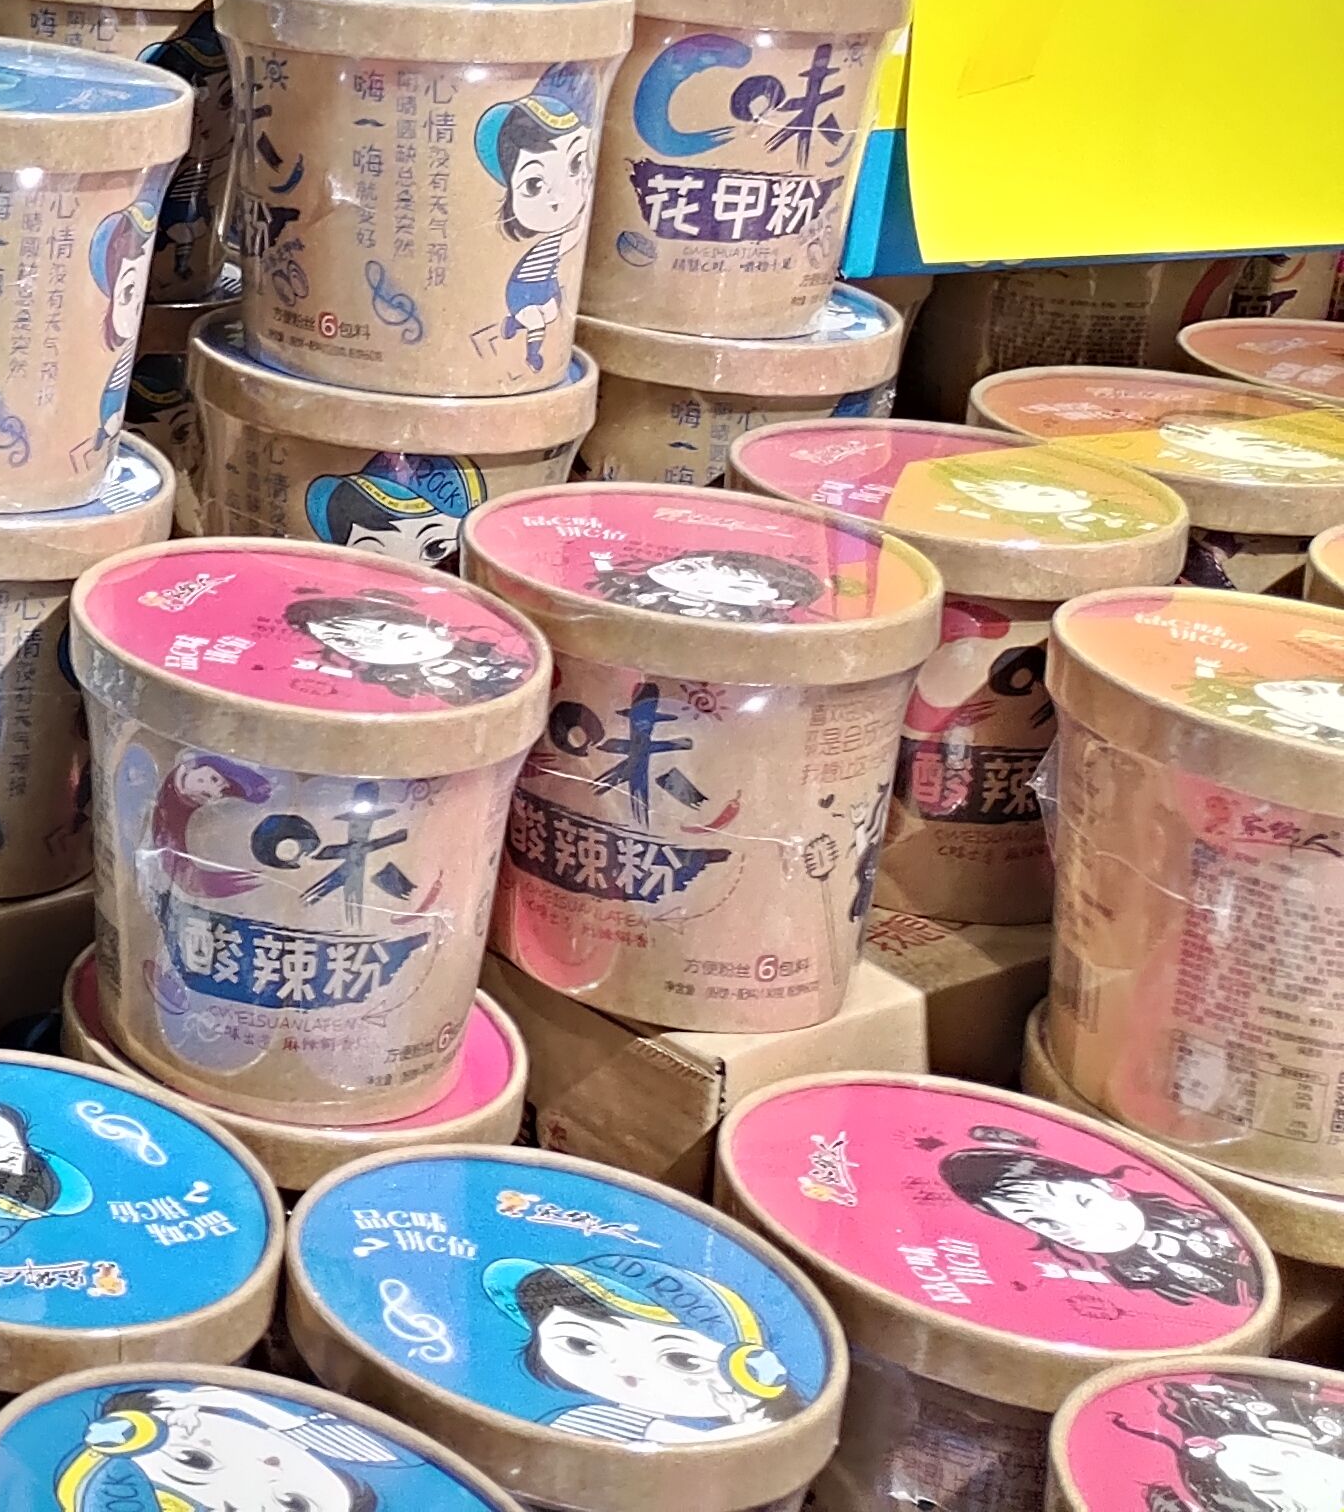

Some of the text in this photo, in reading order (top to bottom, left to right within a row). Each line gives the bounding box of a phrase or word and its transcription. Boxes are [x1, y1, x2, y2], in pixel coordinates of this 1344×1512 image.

[644, 174, 824, 240] 花甲粉
[913, 752, 1039, 814] 酸辣
[514, 804, 691, 903] 酸辣粉
[182, 918, 390, 1002] 酸辣粉
